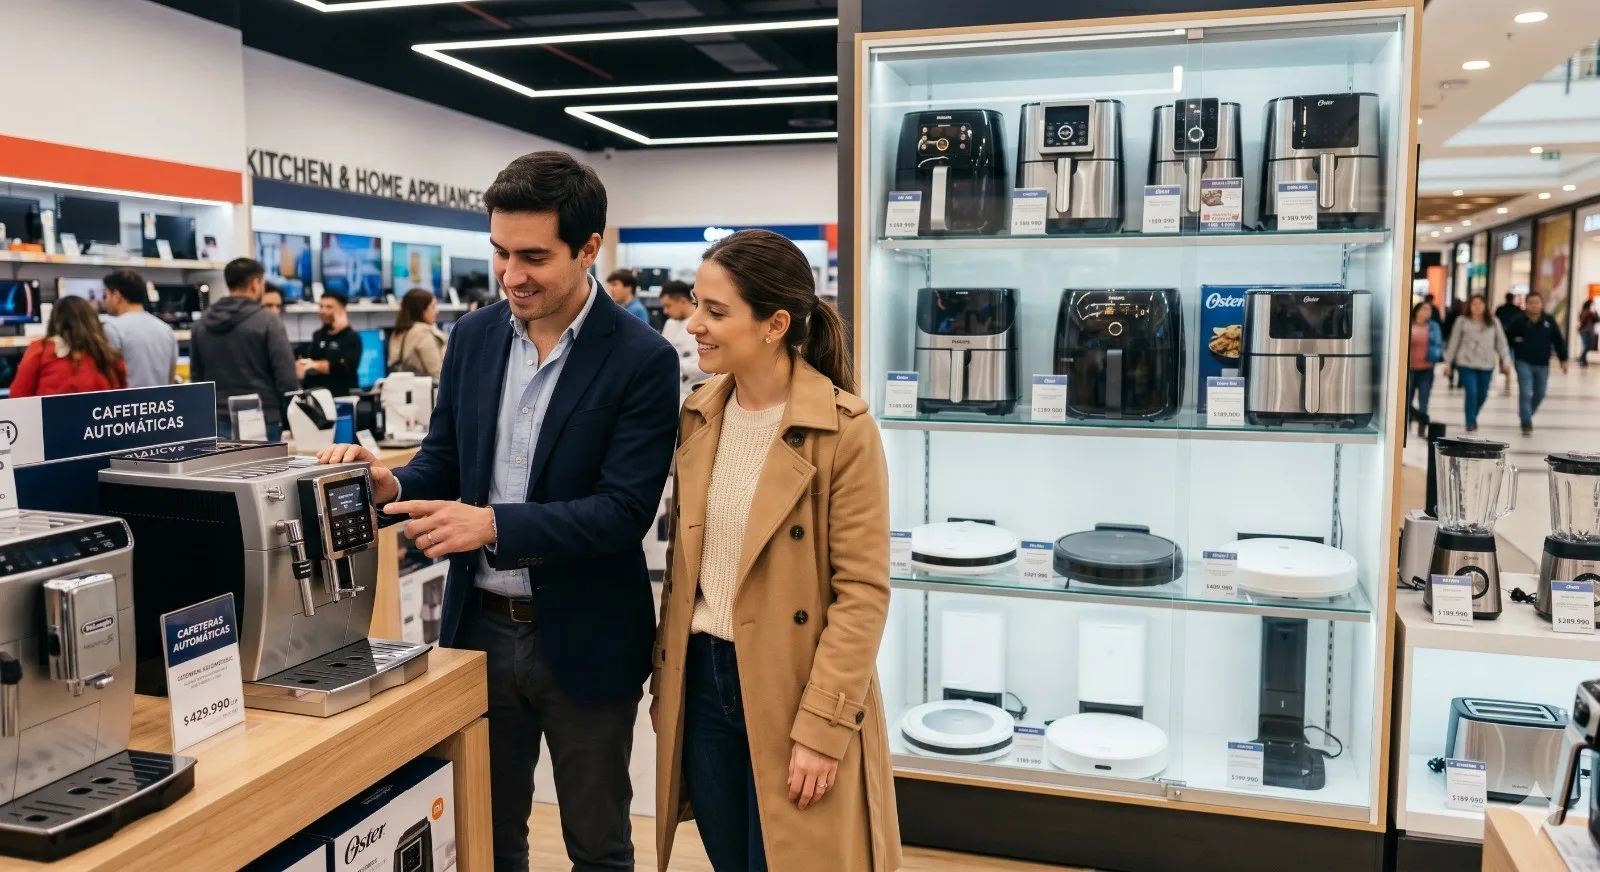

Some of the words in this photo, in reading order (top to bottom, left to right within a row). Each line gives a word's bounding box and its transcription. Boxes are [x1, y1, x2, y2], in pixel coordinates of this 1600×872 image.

[247, 149, 333, 187] KITCHEN
[339, 164, 350, 190] &
[356, 167, 403, 199] HOME
[92, 399, 175, 421] CAFETERAS
[83, 415, 185, 441] AUTOMÁTICAS
[172, 624, 231, 653] AUTOMÁTICAS
[177, 615, 224, 639] CAFETERAS
[183, 697, 230, 726] $429.990
[344, 822, 387, 865] Oster
